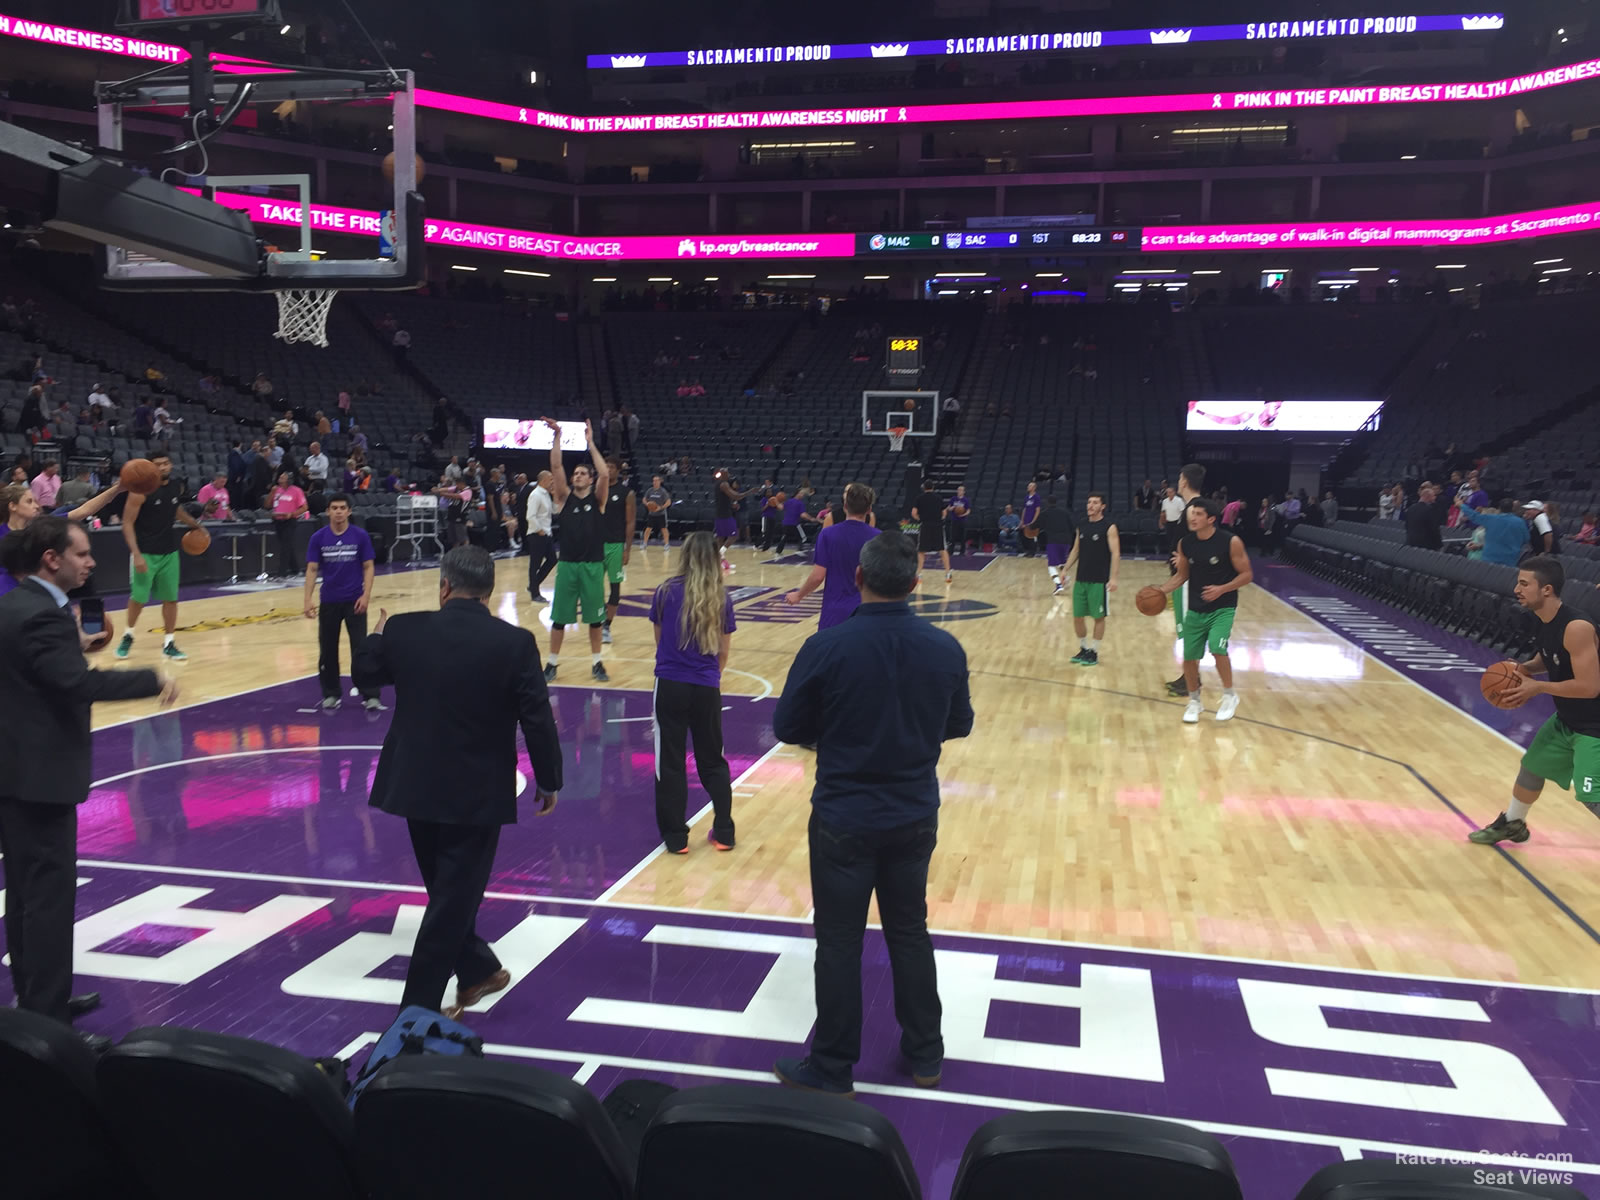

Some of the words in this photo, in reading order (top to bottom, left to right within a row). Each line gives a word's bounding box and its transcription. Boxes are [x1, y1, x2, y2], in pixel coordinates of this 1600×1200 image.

[1246, 17, 1359, 39] SACRAMENTO
[1363, 15, 1417, 34] PROUD
[13, 20, 124, 52] AWARENESS
[128, 40, 180, 62] NIGHT
[946, 33, 1049, 54] SACRAMENTO
[1053, 31, 1102, 48] PROUD
[687, 46, 782, 65] SACRAMENTO
[786, 44, 831, 61] PROUD
[1234, 92, 1272, 107] PINK
[1274, 91, 1291, 106] IN
[1295, 90, 1325, 104] THE
[1328, 88, 1376, 103] PAINT
[1379, 85, 1442, 101] BREAST
[1445, 80, 1507, 99] HEALTH
[537, 111, 568, 129] PINK
[571, 117, 585, 131] IN
[587, 117, 612, 130] THE
[614, 116, 653, 130] PAINT
[655, 115, 705, 129] BREAST
[708, 113, 758, 128] HEALTH
[760, 110, 843, 126] AWARENESS
[845, 108, 888, 123] NIGHT
[260, 203, 303, 223] TAKE
[310, 210, 345, 228] THE
[350, 215, 381, 233] FIRS
[441, 228, 506, 247] AGAINST
[508, 234, 560, 254] BREAST
[563, 241, 624, 257] CANCER.
[965, 235, 986, 246] SAC
[1009, 234, 1018, 244] 0
[1032, 233, 1050, 243] 1ST
[1151, 234, 1174, 245] can
[1177, 231, 1206, 245] take
[1208, 230, 1277, 246] advantage
[1280, 228, 1297, 241] of
[1299, 228, 1345, 241] walk-in
[1348, 226, 1392, 244] digital
[1394, 226, 1491, 242] mammograms
[1494, 222, 1509, 236] at
[1511, 212, 1591, 234] Sacramento
[699, 240, 819, 256] kp.org/breastcancer
[887, 236, 910, 247] MAC
[931, 236, 940, 246] 0
[1582, 776, 1593, 793] 5
[0, 876, 1567, 1126] SACRA
